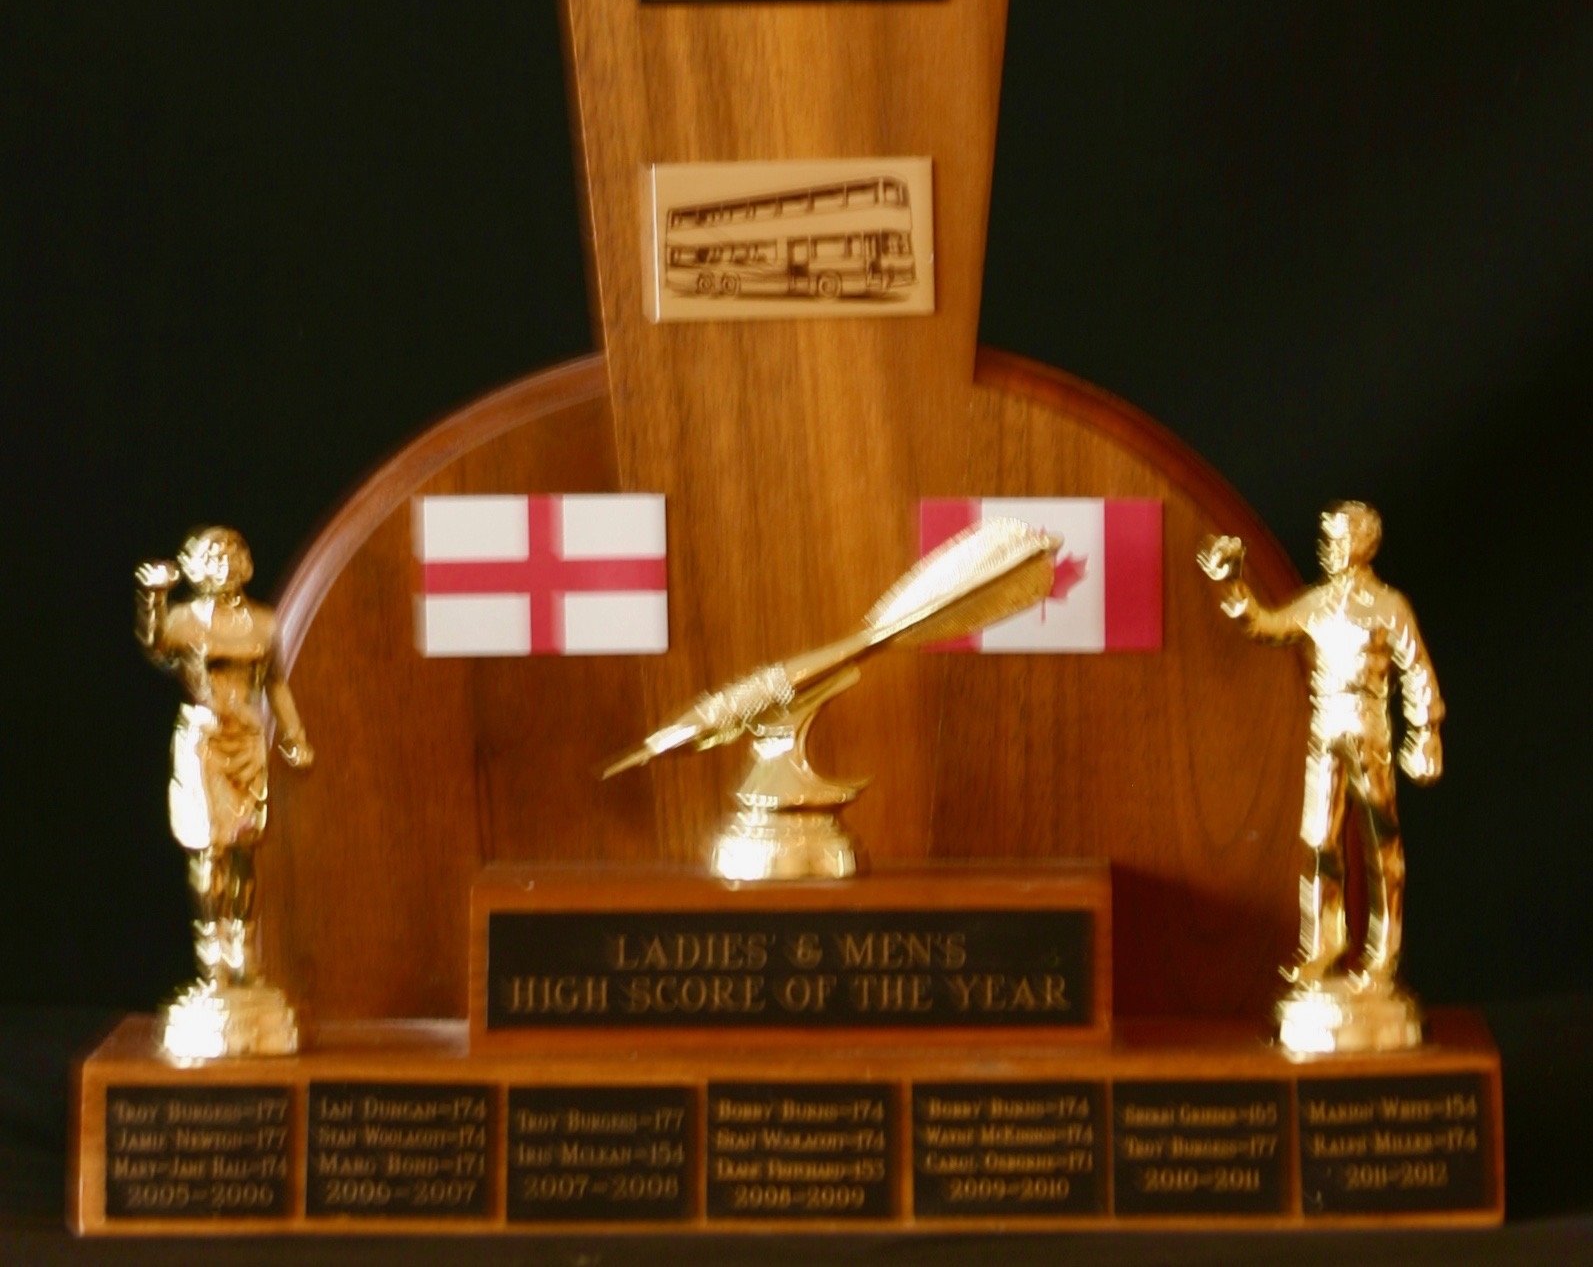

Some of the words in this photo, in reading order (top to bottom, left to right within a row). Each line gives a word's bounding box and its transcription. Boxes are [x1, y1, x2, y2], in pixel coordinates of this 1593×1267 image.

[613, 931, 776, 970] LADIES'
[790, 933, 823, 968] &
[841, 931, 967, 968] MEN'S
[509, 975, 610, 1014] HIGH
[628, 975, 765, 1013] SCORE
[781, 975, 838, 1011] OF
[854, 975, 934, 1011] THE
[950, 974, 1070, 1010] YEAR
